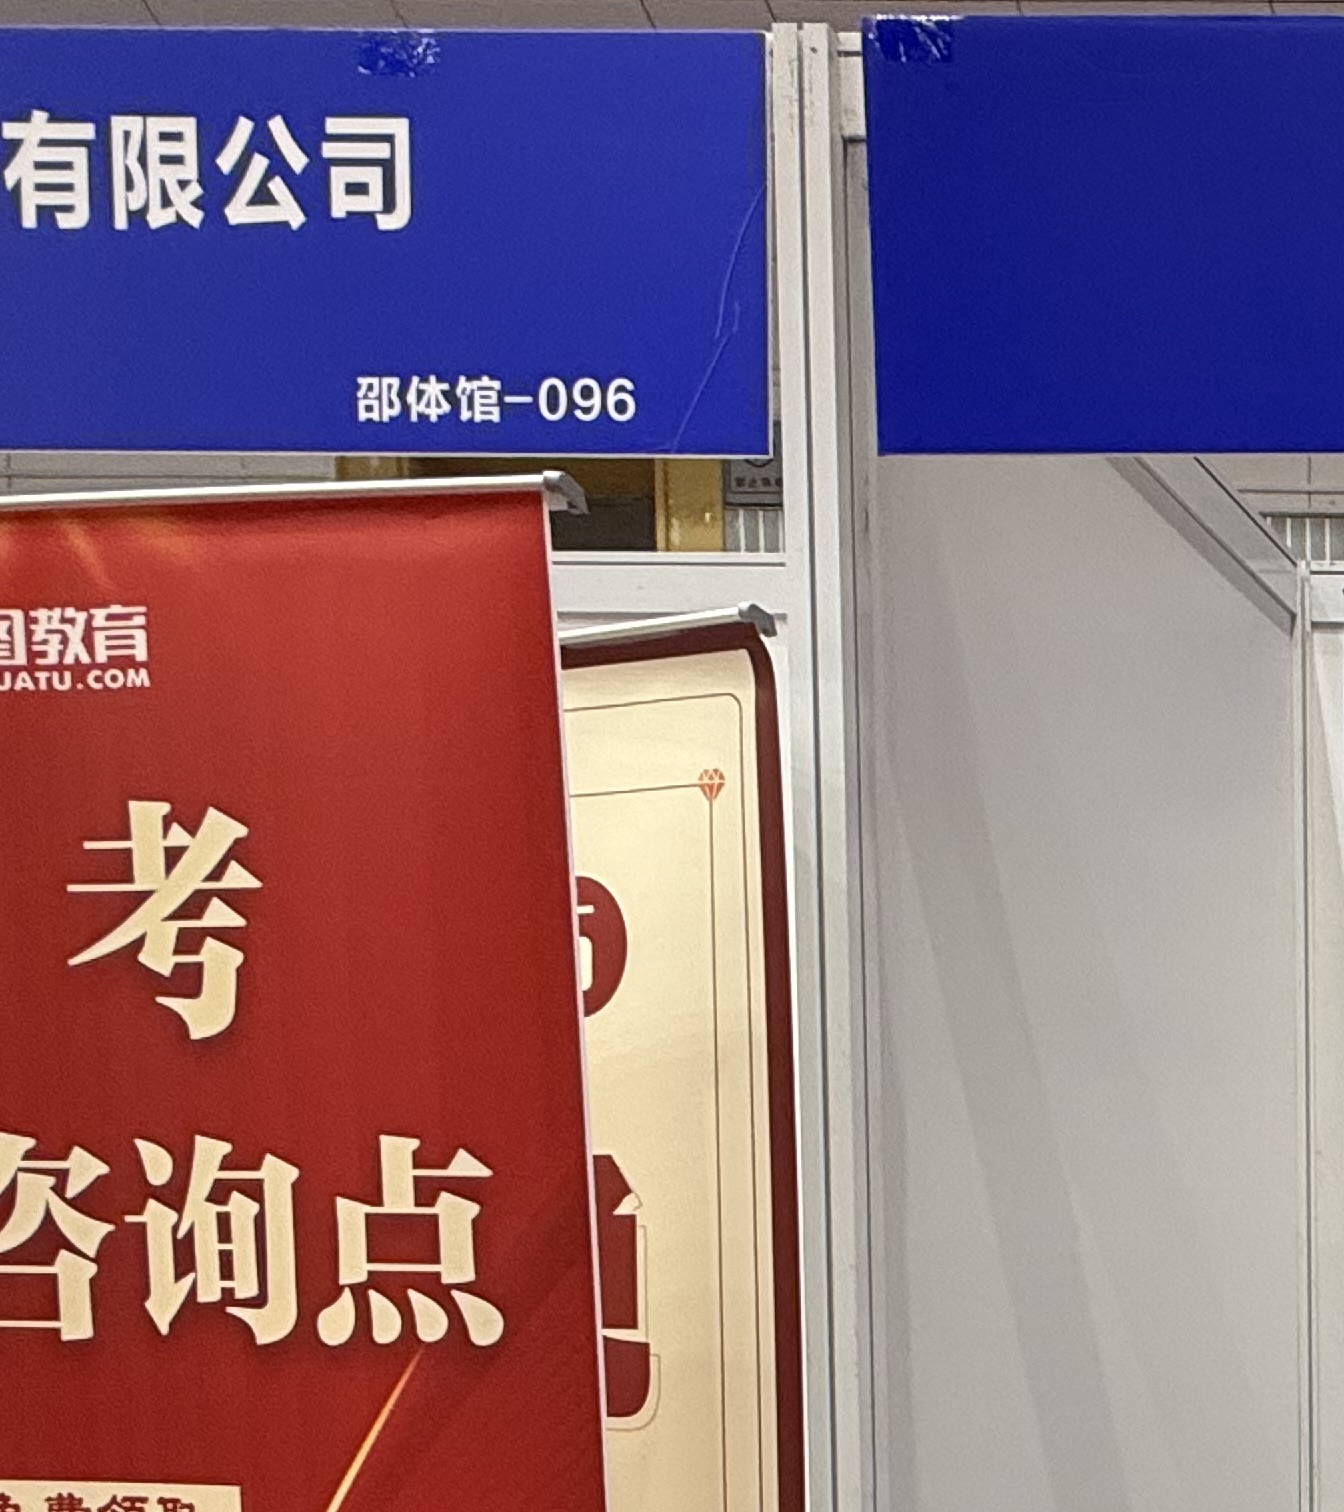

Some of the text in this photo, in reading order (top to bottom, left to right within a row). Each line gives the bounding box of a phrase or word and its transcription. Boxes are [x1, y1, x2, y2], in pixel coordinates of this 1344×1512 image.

[2, 109, 412, 231] 有限公司
[356, 374, 637, 424] 邵体馆-096
[67, 800, 263, 1041] 考
[0, 1131, 504, 1347] 咨询点
